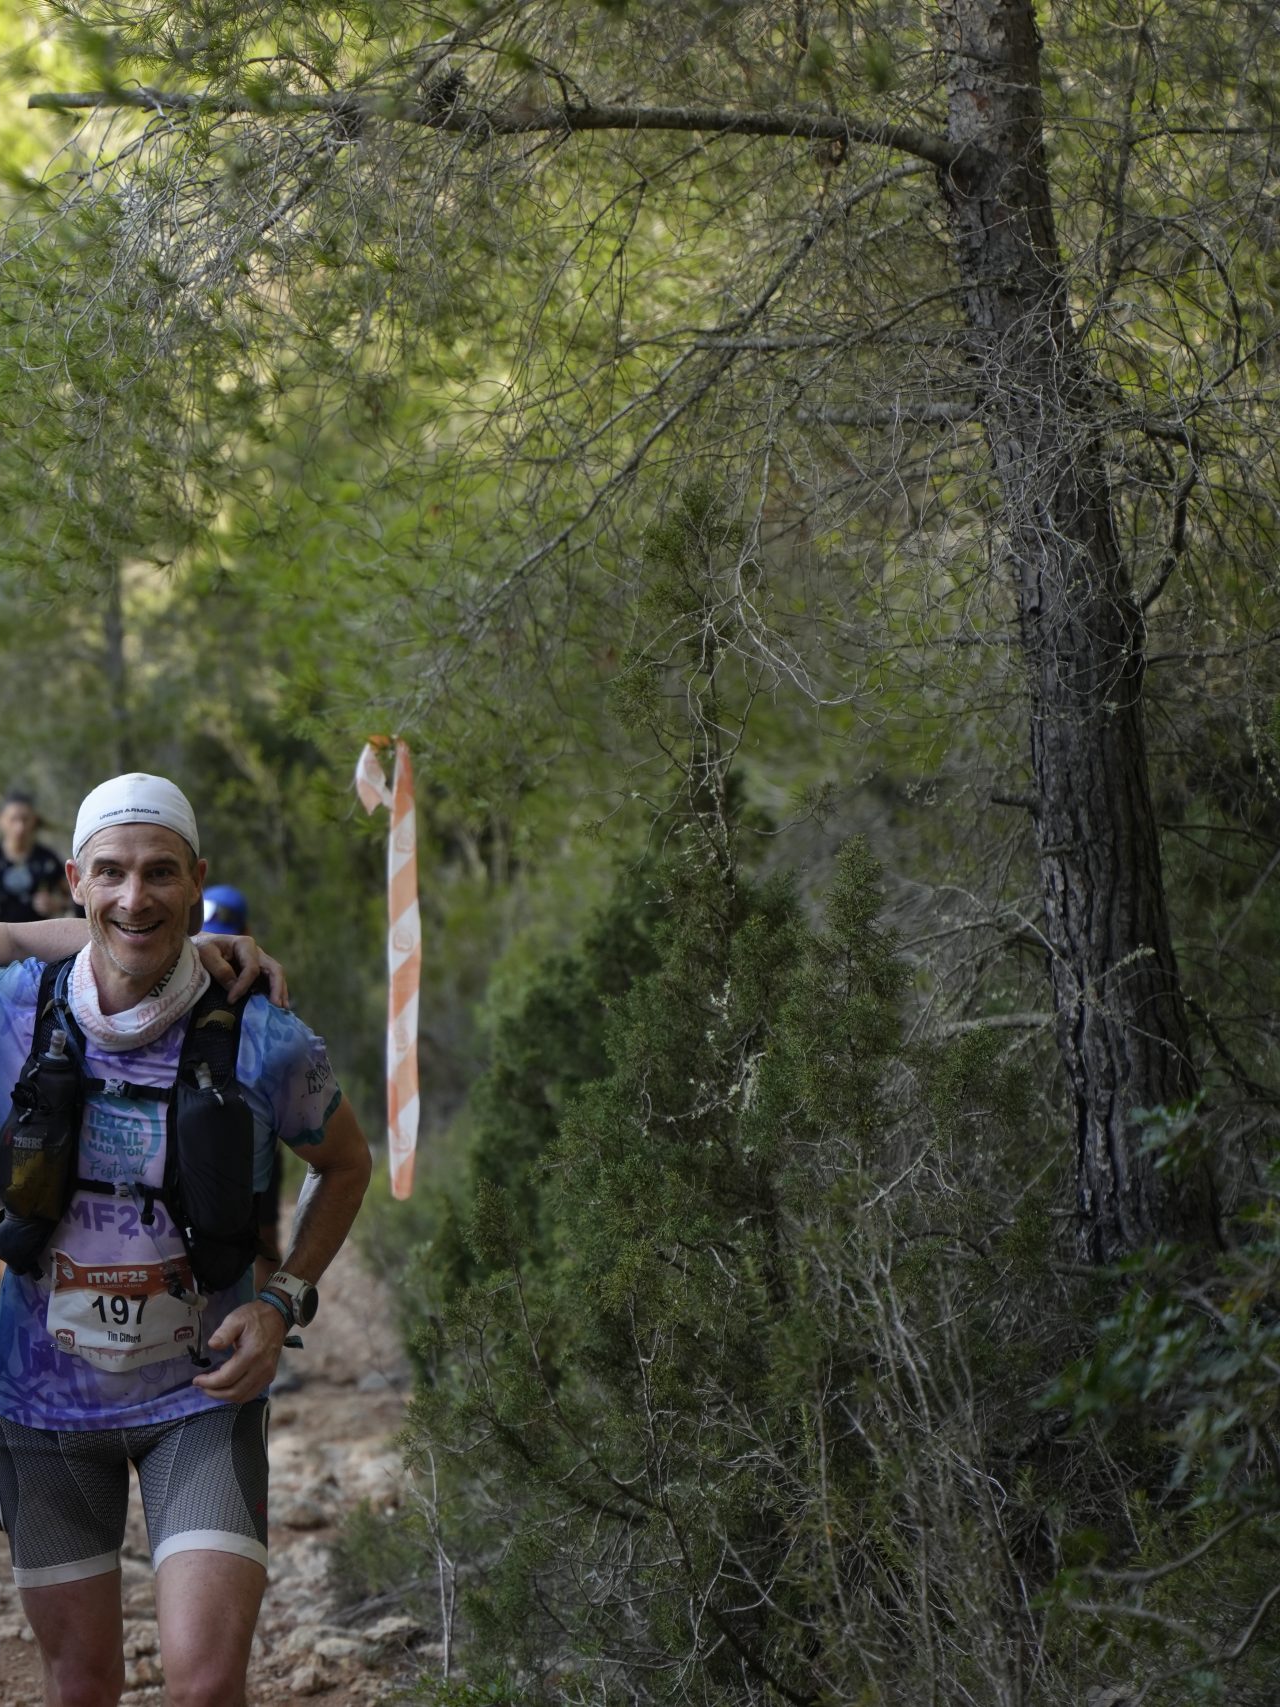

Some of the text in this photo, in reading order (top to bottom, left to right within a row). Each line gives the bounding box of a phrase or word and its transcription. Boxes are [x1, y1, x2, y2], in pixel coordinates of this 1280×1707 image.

[100, 807, 160, 820] UNDER ARMOUR
[88, 1126, 144, 1147] TRAIL
[87, 1270, 149, 1284] ITMF25
[92, 1294, 149, 1325] 197
[107, 1330, 118, 1342] Tim
